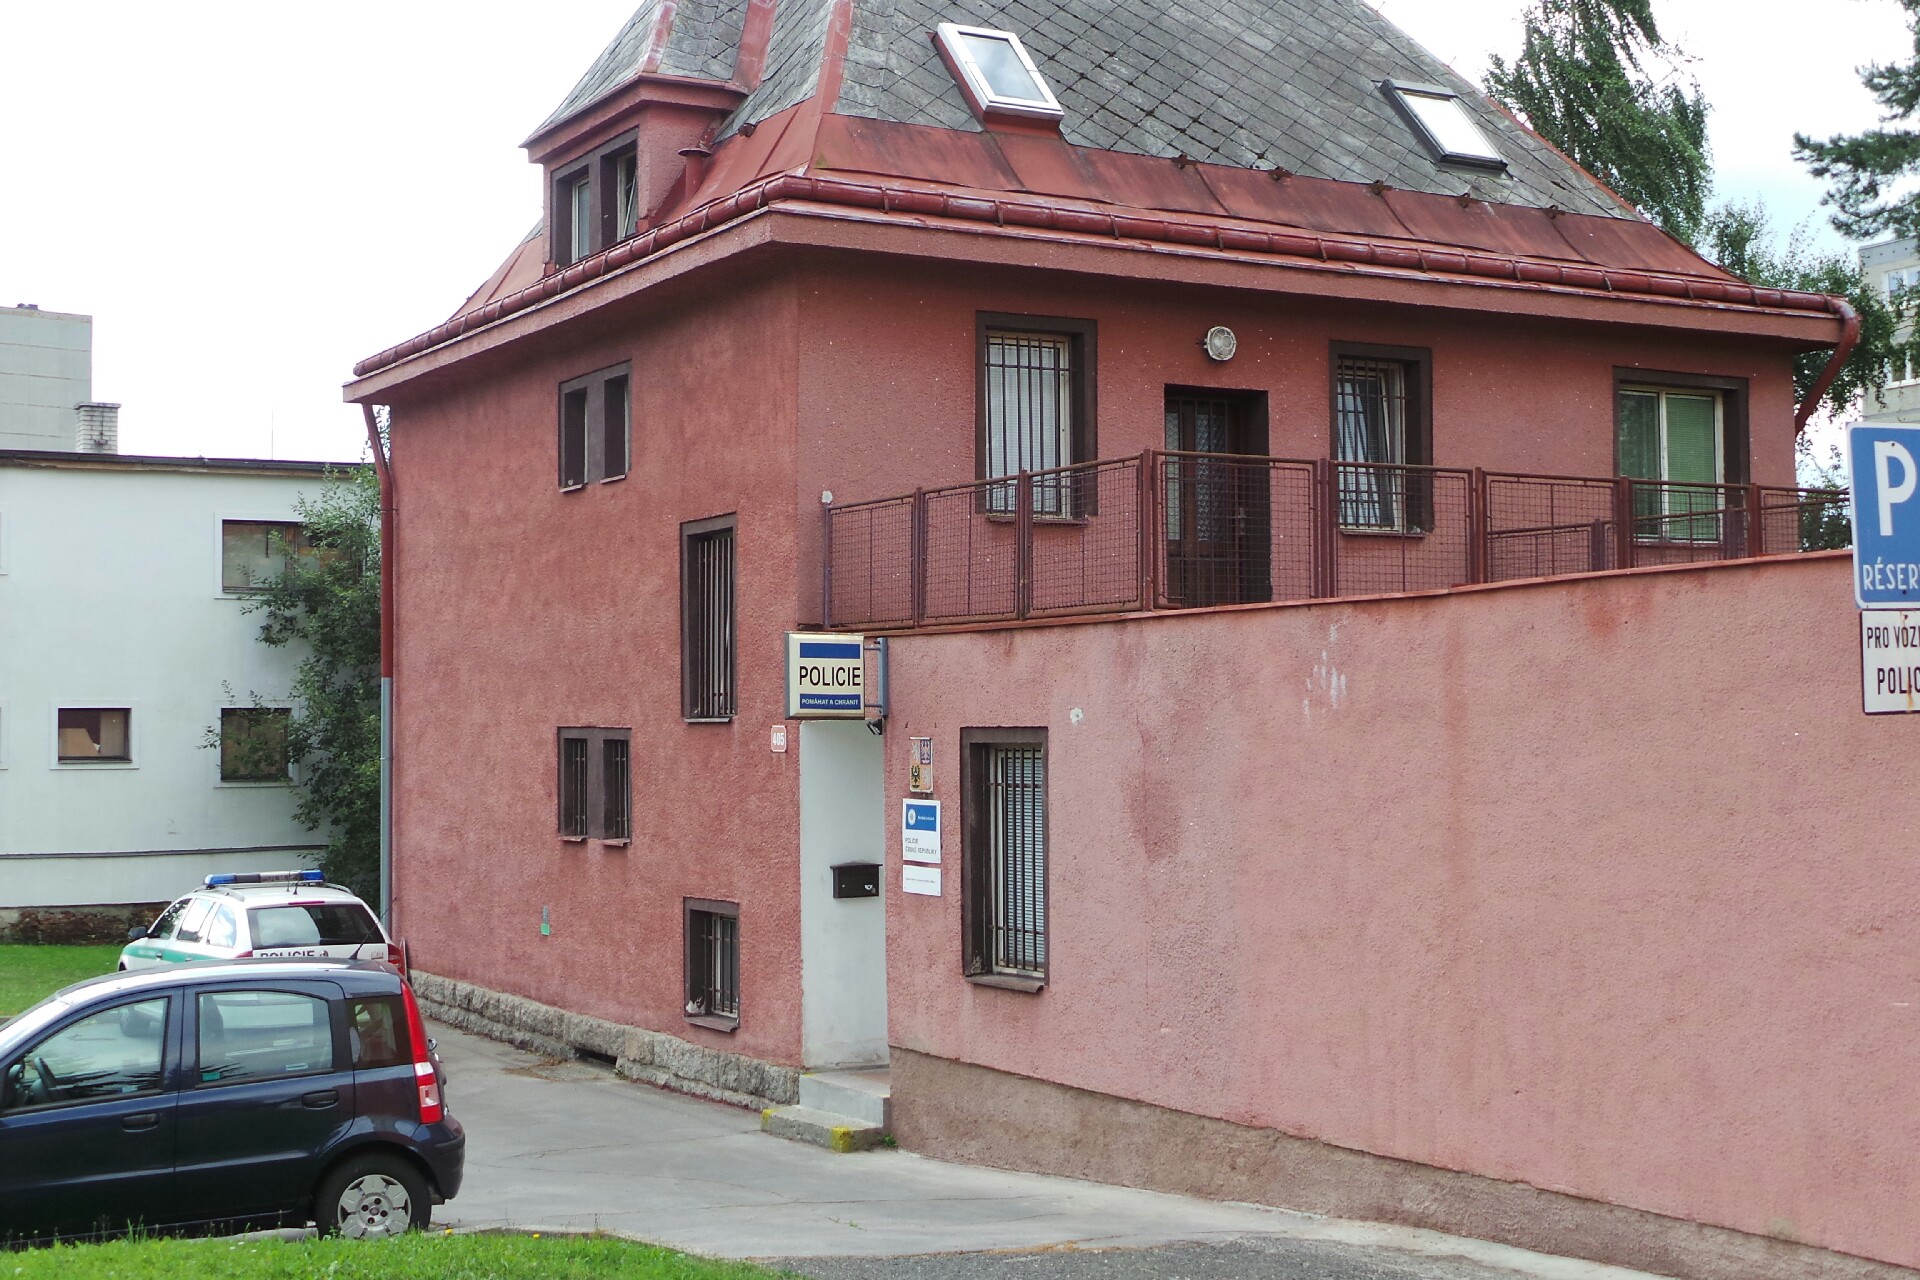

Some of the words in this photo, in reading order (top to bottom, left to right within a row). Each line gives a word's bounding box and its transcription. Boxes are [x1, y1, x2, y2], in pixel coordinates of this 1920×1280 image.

[1874, 440, 1917, 536] P
[1863, 556, 1920, 590] RÉSER
[1867, 626, 1889, 648] PRO
[1893, 625, 1920, 648] VOZ
[799, 666, 861, 686] POLICIE
[772, 732, 784, 745] 405
